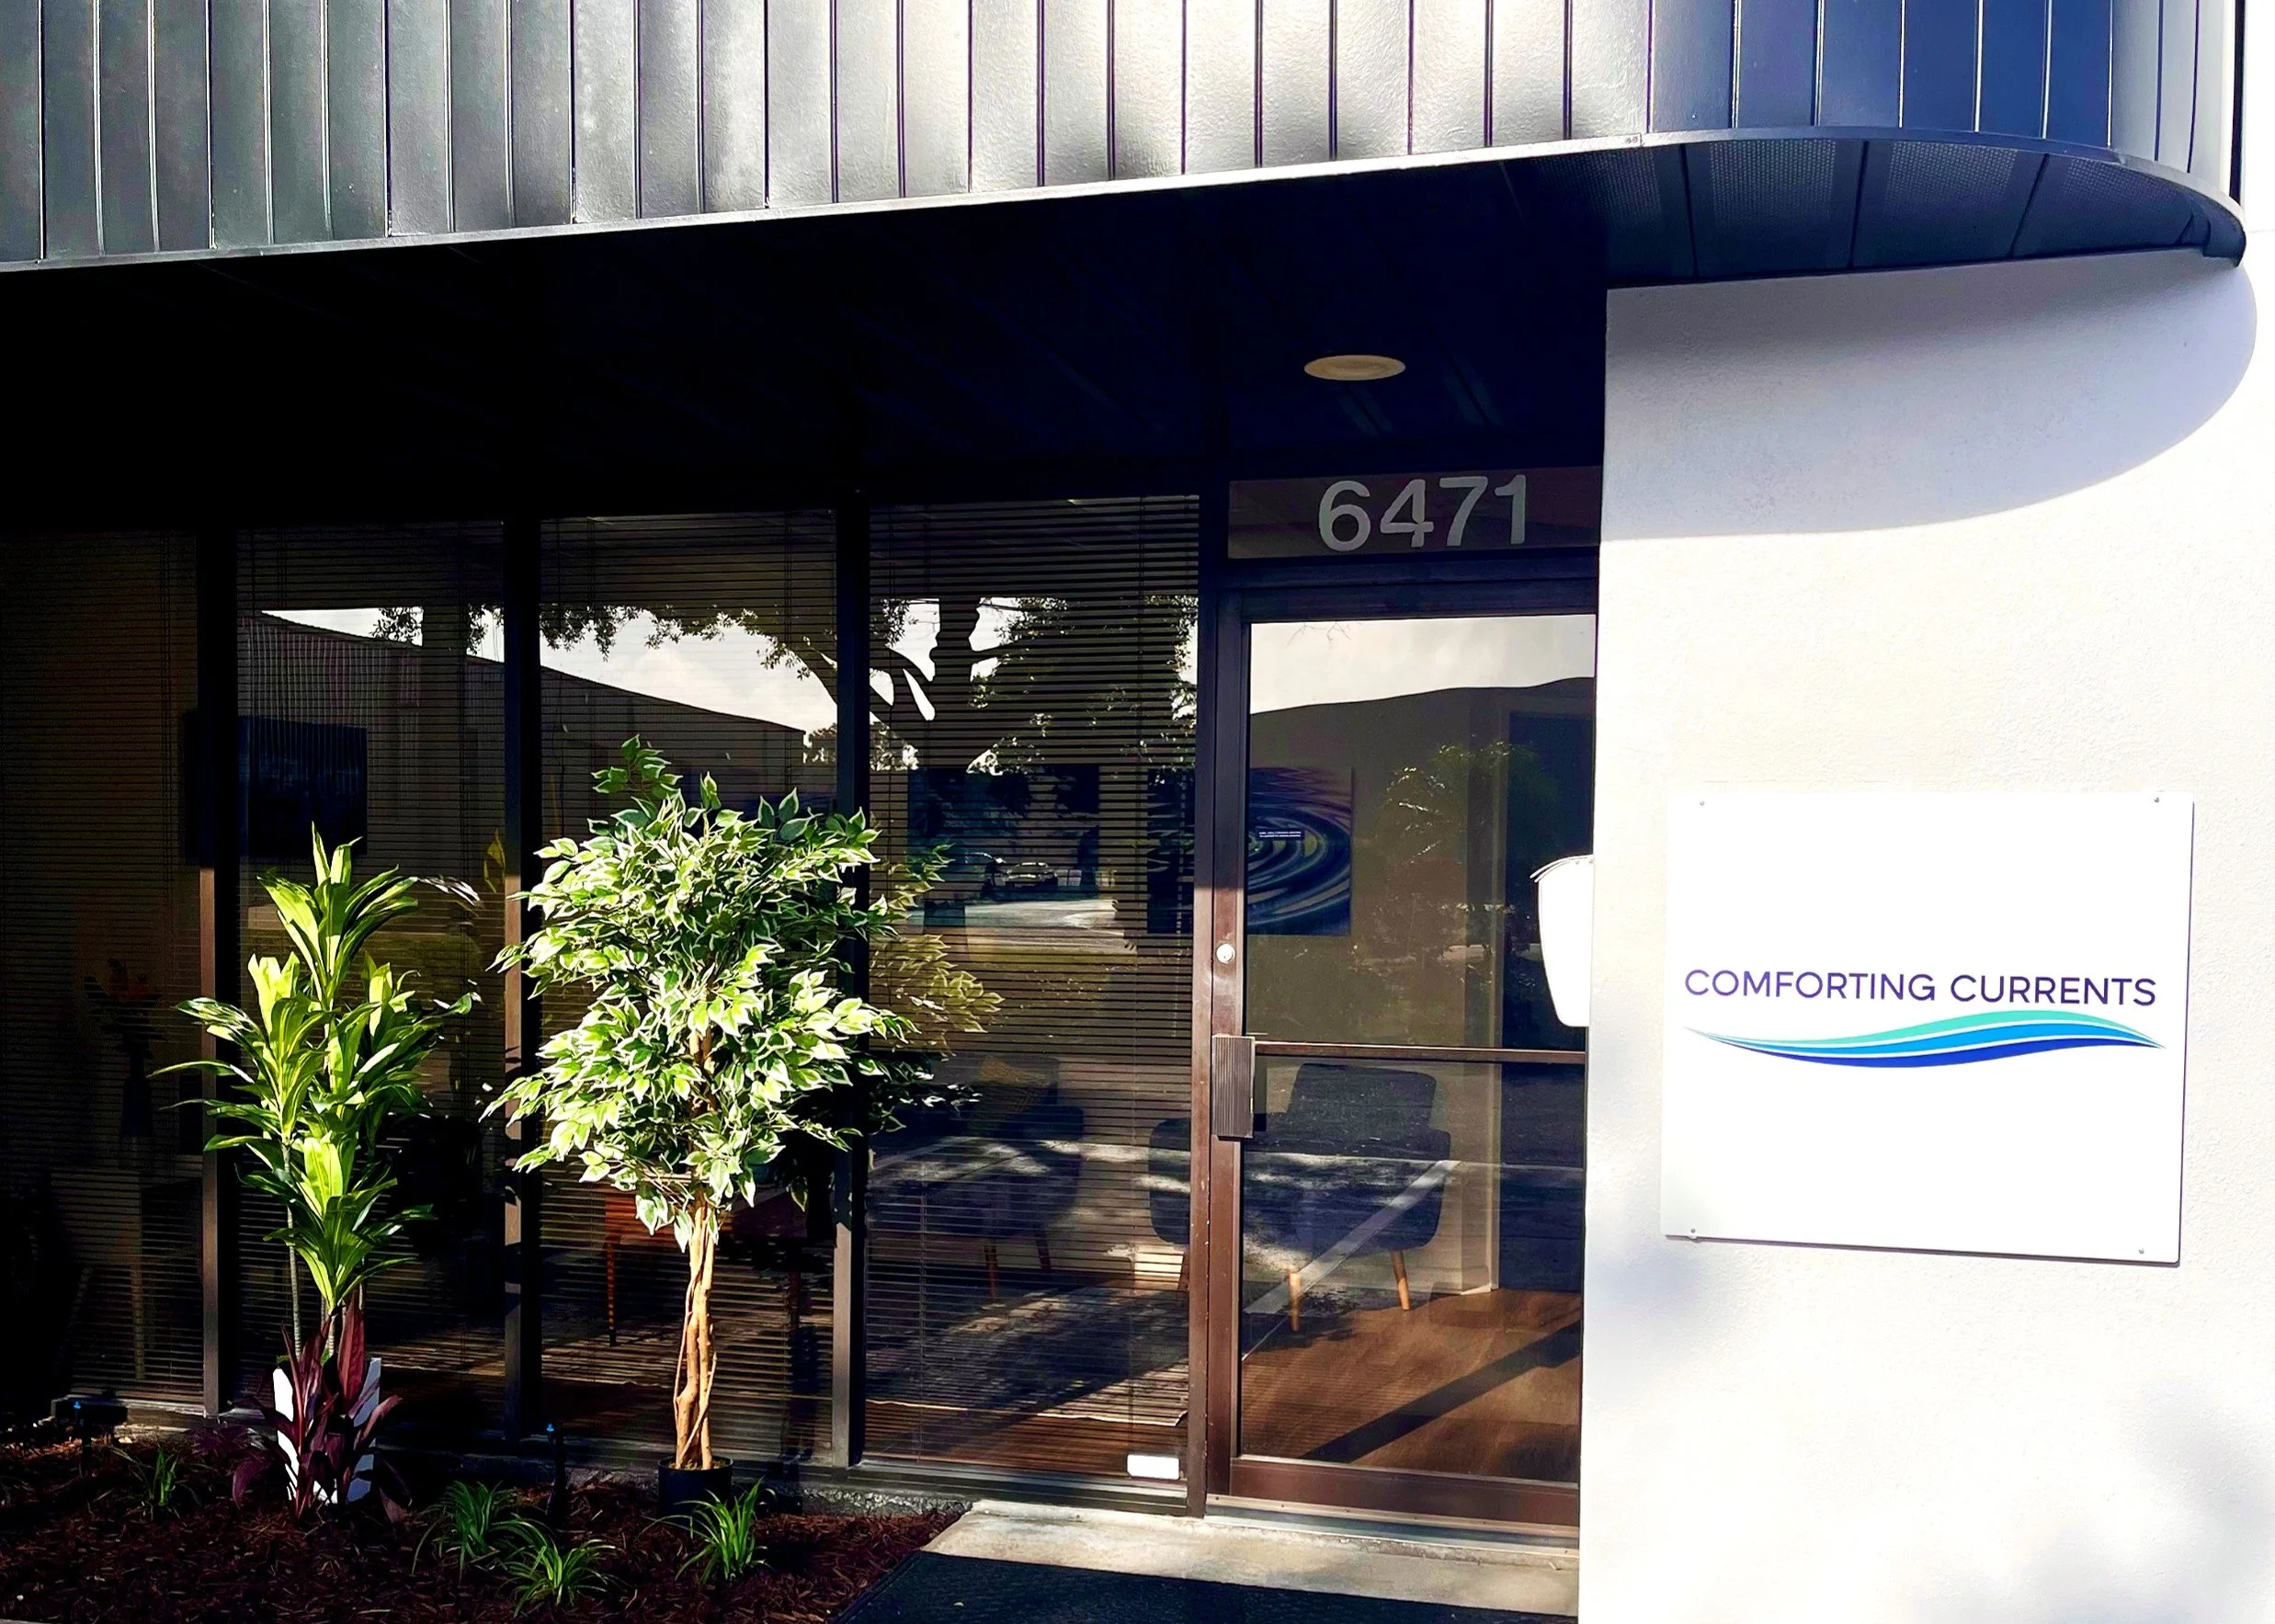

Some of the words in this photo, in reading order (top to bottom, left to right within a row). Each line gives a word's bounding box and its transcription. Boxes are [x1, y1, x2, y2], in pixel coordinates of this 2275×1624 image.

[1318, 474, 1527, 551] 6471
[1685, 969, 1936, 1002] COMFORTING
[1950, 974, 2156, 1006] CURRENTS
